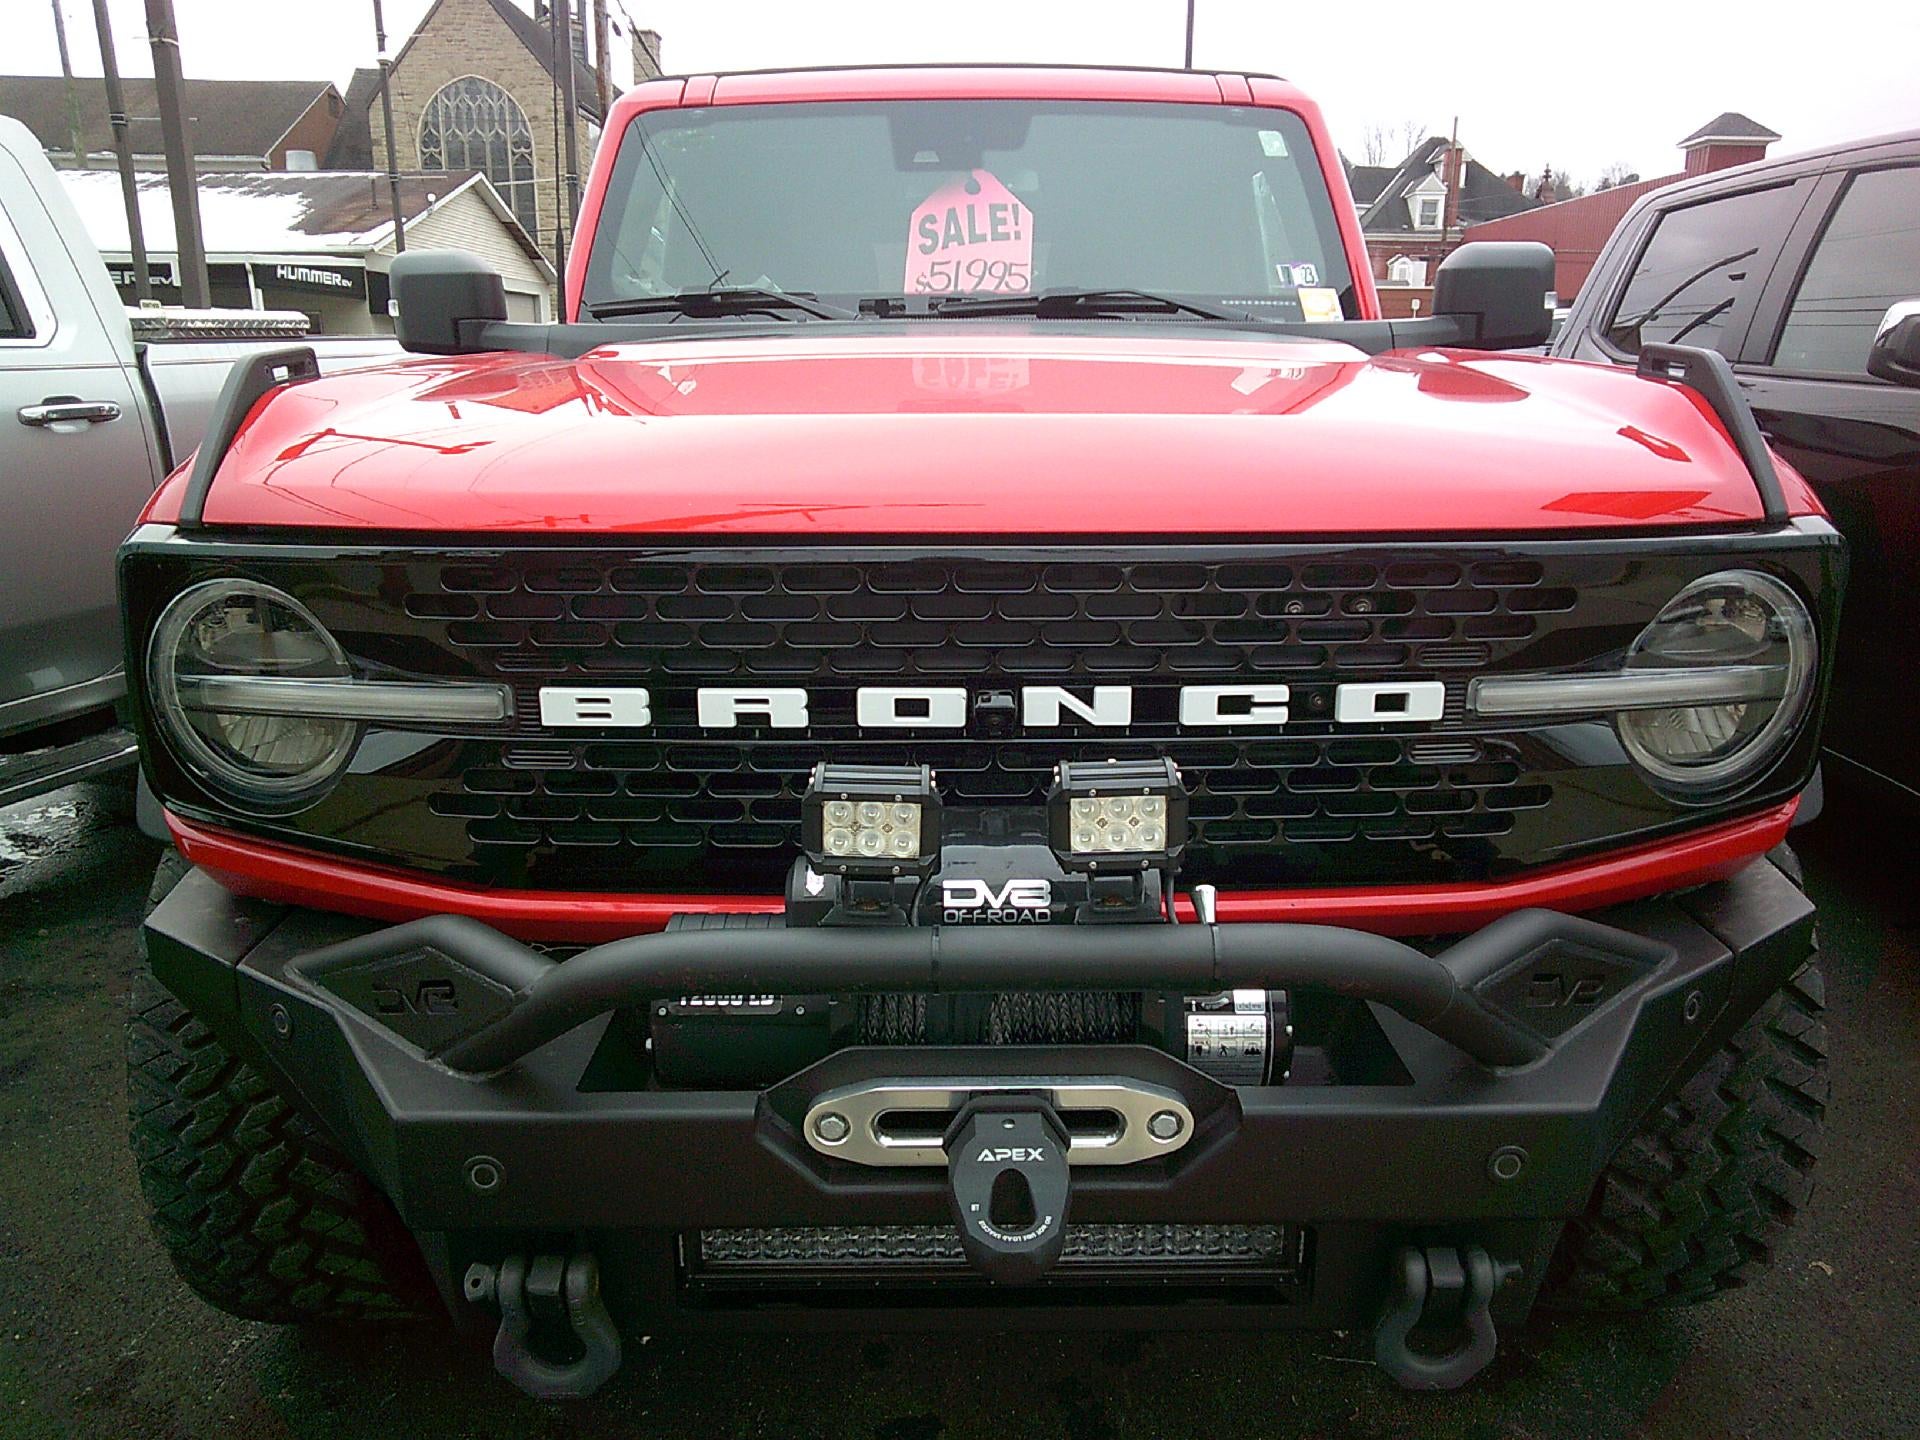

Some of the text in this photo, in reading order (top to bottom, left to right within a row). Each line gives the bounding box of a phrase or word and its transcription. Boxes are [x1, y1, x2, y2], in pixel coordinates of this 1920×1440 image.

[918, 204, 1021, 255] SALE!
[276, 264, 342, 286] HUMMER
[915, 258, 1029, 294] $51995
[539, 681, 1446, 728] BRONCO
[942, 879, 1052, 908] DV8
[943, 909, 1051, 923] OFFROAD
[976, 1148, 1045, 1161] APEX
